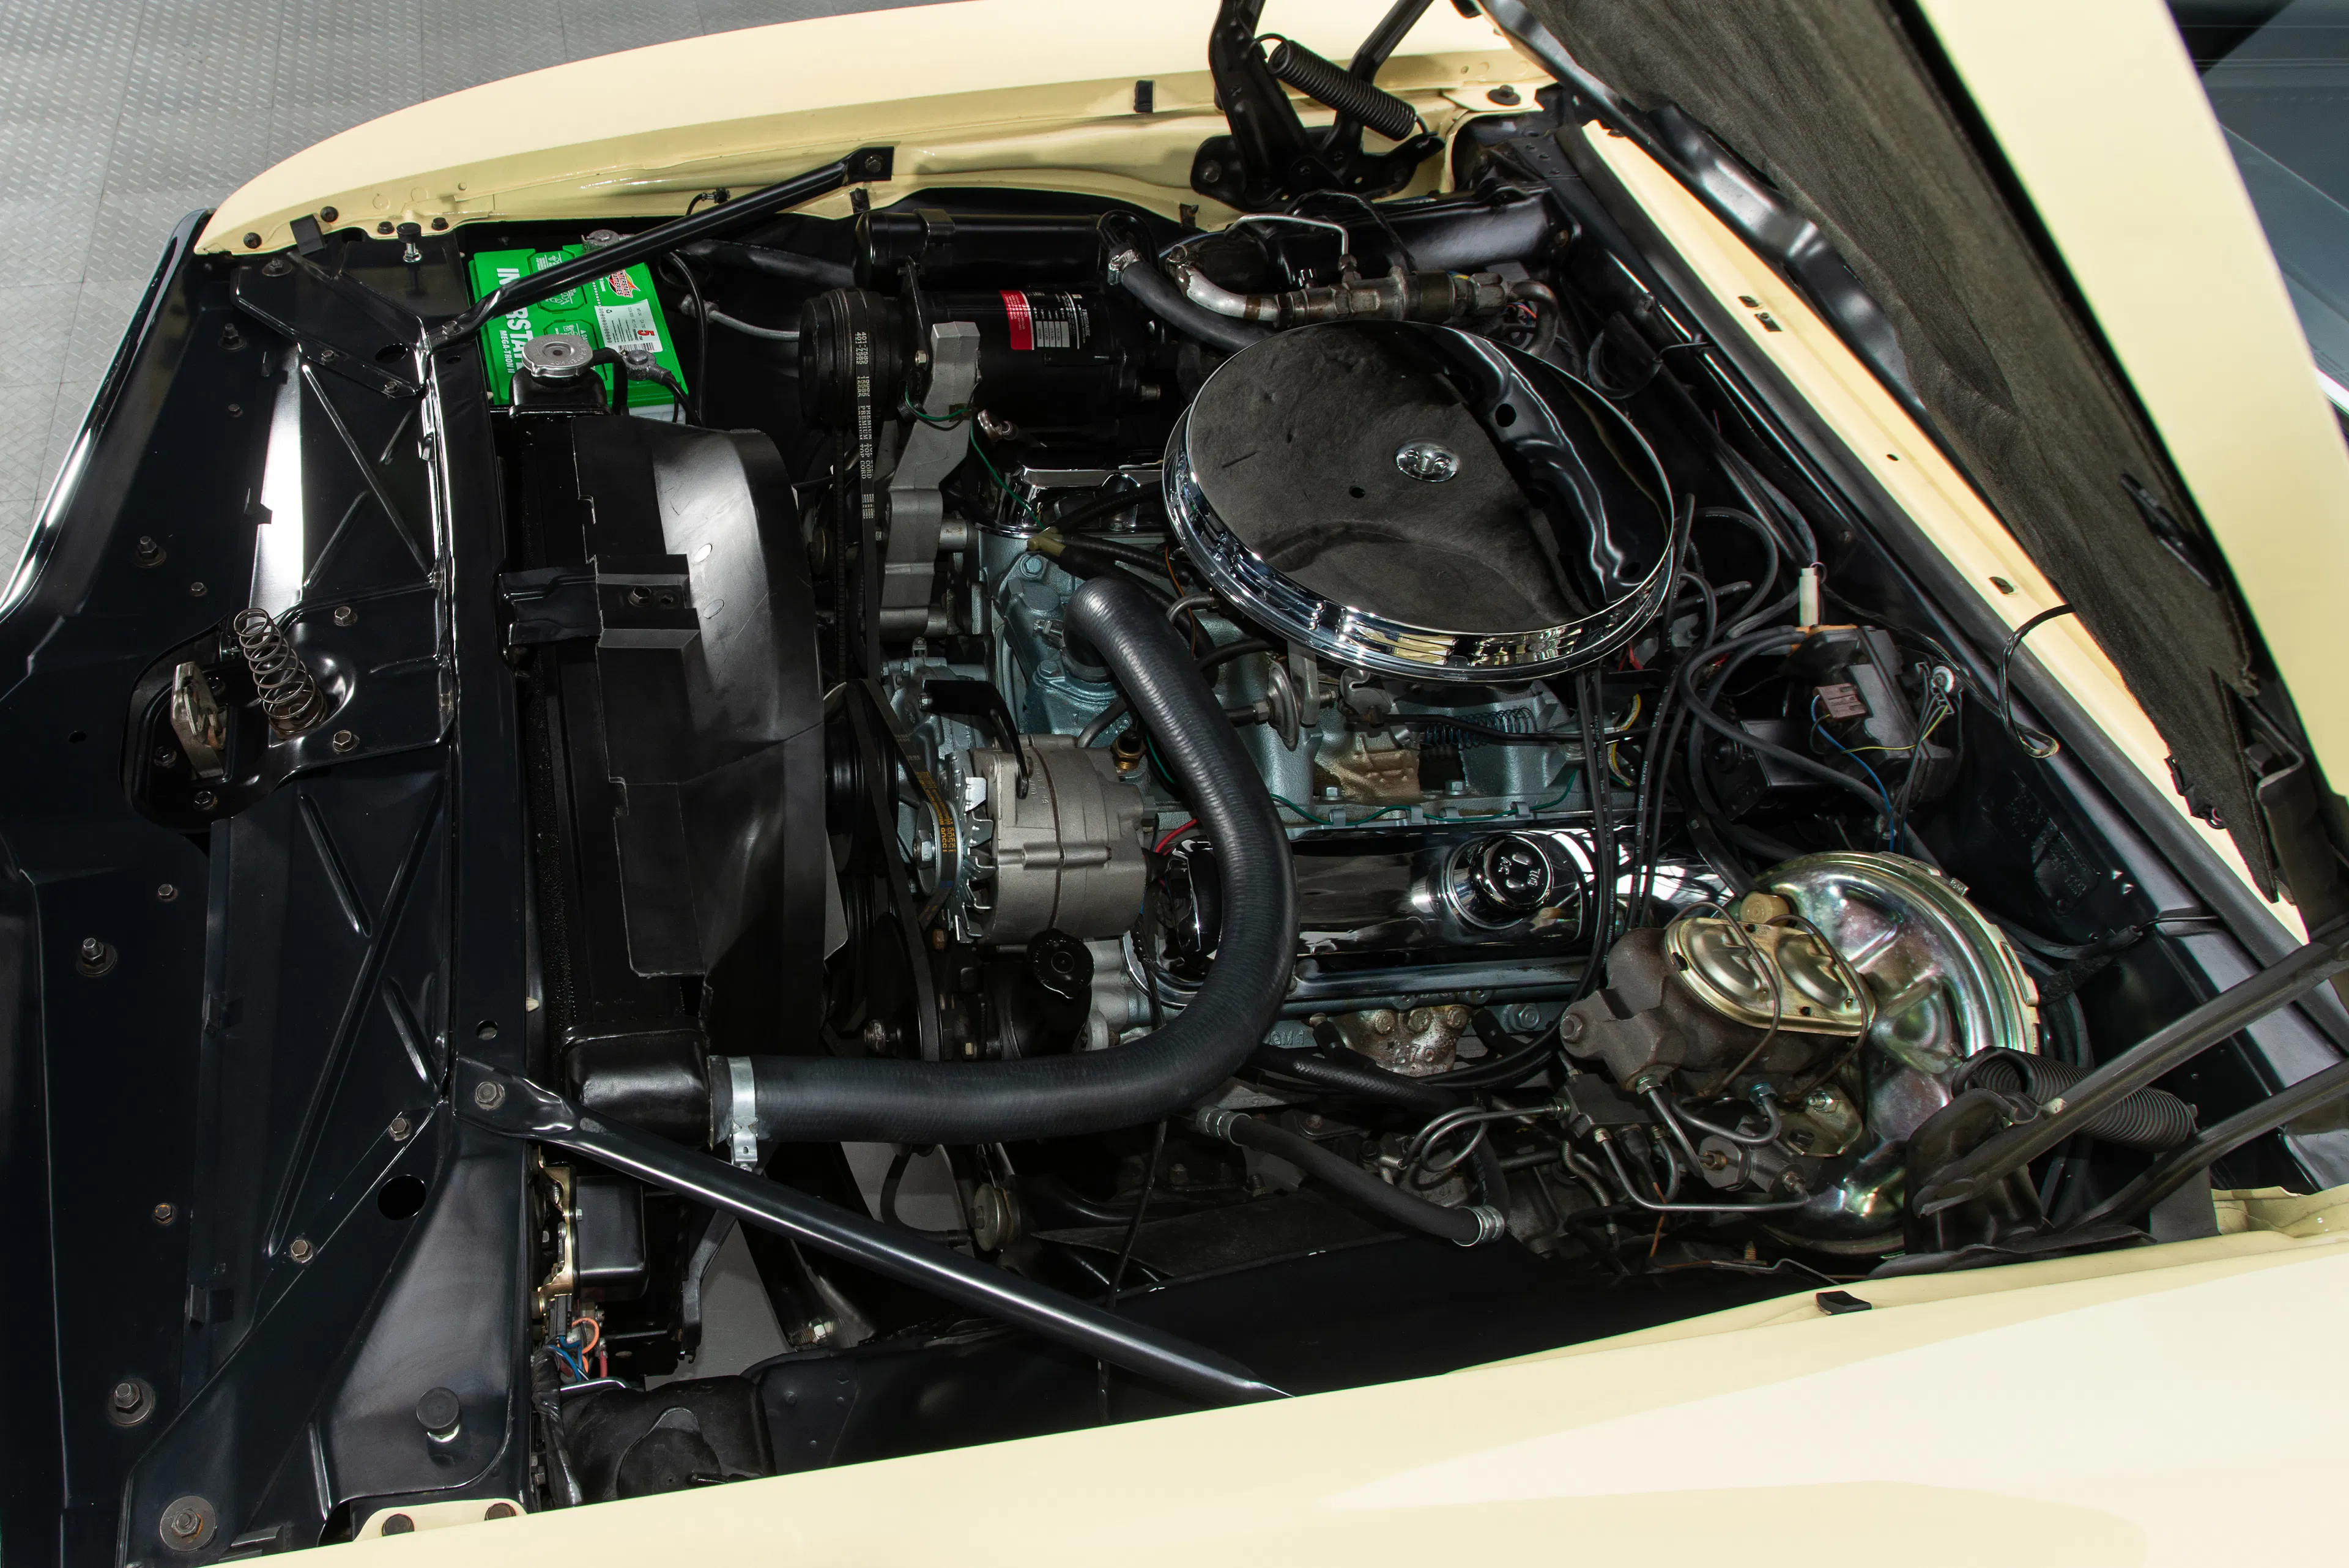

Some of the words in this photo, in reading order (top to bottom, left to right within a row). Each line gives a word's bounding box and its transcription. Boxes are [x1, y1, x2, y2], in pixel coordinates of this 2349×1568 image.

[618, 270, 631, 297] NTERSTATE
[499, 330, 513, 367] MEGA-TRON
[1527, 868, 1541, 886] OIL
